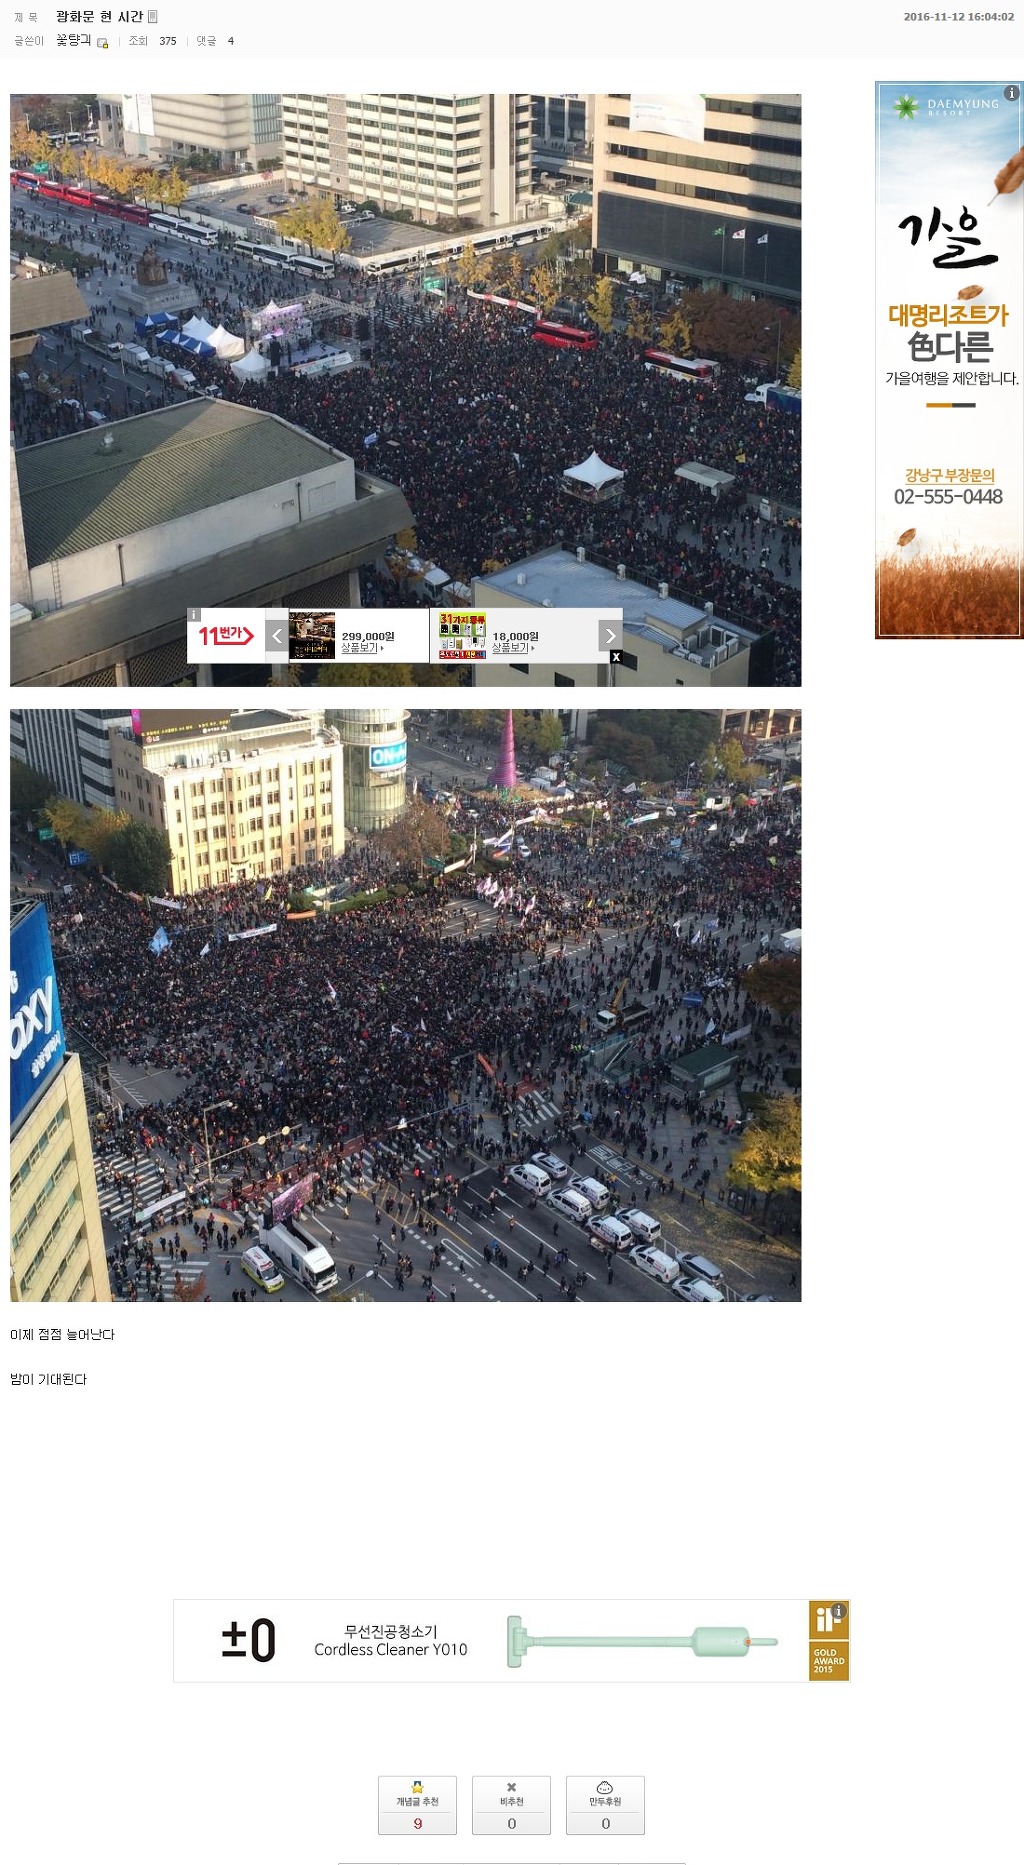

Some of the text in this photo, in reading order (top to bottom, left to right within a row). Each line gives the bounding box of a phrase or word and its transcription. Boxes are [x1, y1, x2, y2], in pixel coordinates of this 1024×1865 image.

[57, 11, 144, 22] 광화문 현 시간
[904, 13, 1015, 21] 2016-11-12 16:04:02
[15, 36, 44, 46] 글쓴이
[129, 36, 177, 46] 조회 375
[197, 36, 235, 46] 댓글 4
[928, 99, 999, 109] DAEMYUNG
[898, 205, 999, 269] 가을
[889, 304, 1009, 327] 대명리조트가
[908, 331, 993, 363] 色다른
[886, 372, 1019, 385] 가을여행을 제안합니다.
[906, 468, 995, 482] 강남구 부장문의
[894, 489, 1003, 504] 02-555-0448
[11, 1329, 115, 1340] 이제 점점 늘어난다
[11, 1373, 87, 1385] 밤이 기대된다
[344, 1625, 437, 1639] 무선진공청소기
[315, 1642, 467, 1656] Cordless Cleaner Y010
[397, 1797, 439, 1806] 개념글 추천
[501, 1797, 523, 1806] 비추천
[590, 1797, 621, 1806] 만두후원
[414, 1818, 422, 1829] 9
[508, 1818, 516, 1829] 0
[602, 1818, 610, 1829] 0
